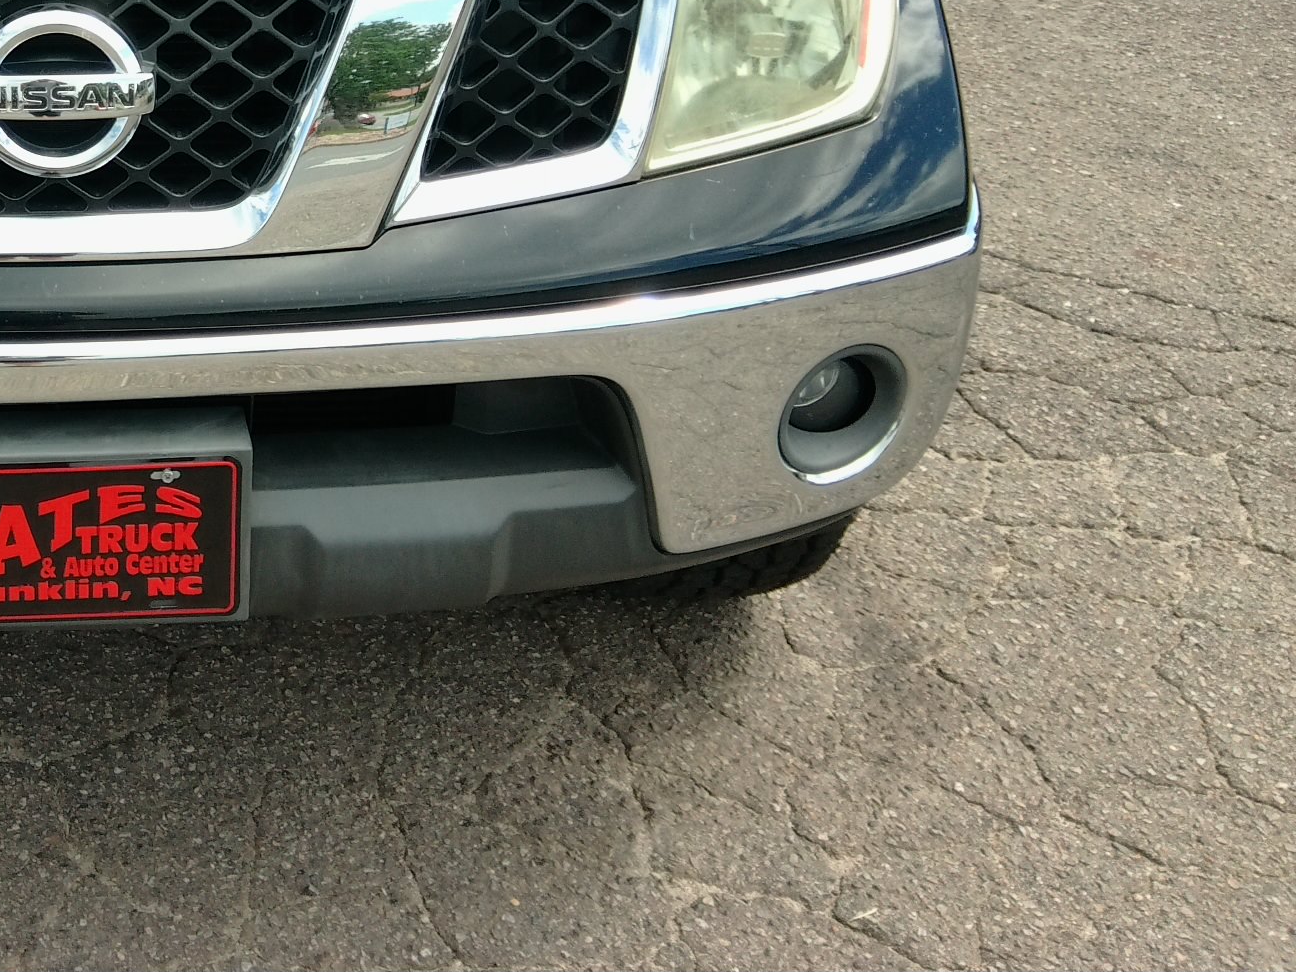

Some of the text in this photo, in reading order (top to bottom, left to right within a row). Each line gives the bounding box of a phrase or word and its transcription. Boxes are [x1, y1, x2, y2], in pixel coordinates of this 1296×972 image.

[75, 521, 199, 555] TRUCK
[40, 553, 204, 579] & Auto Center
[147, 575, 203, 597] NC
